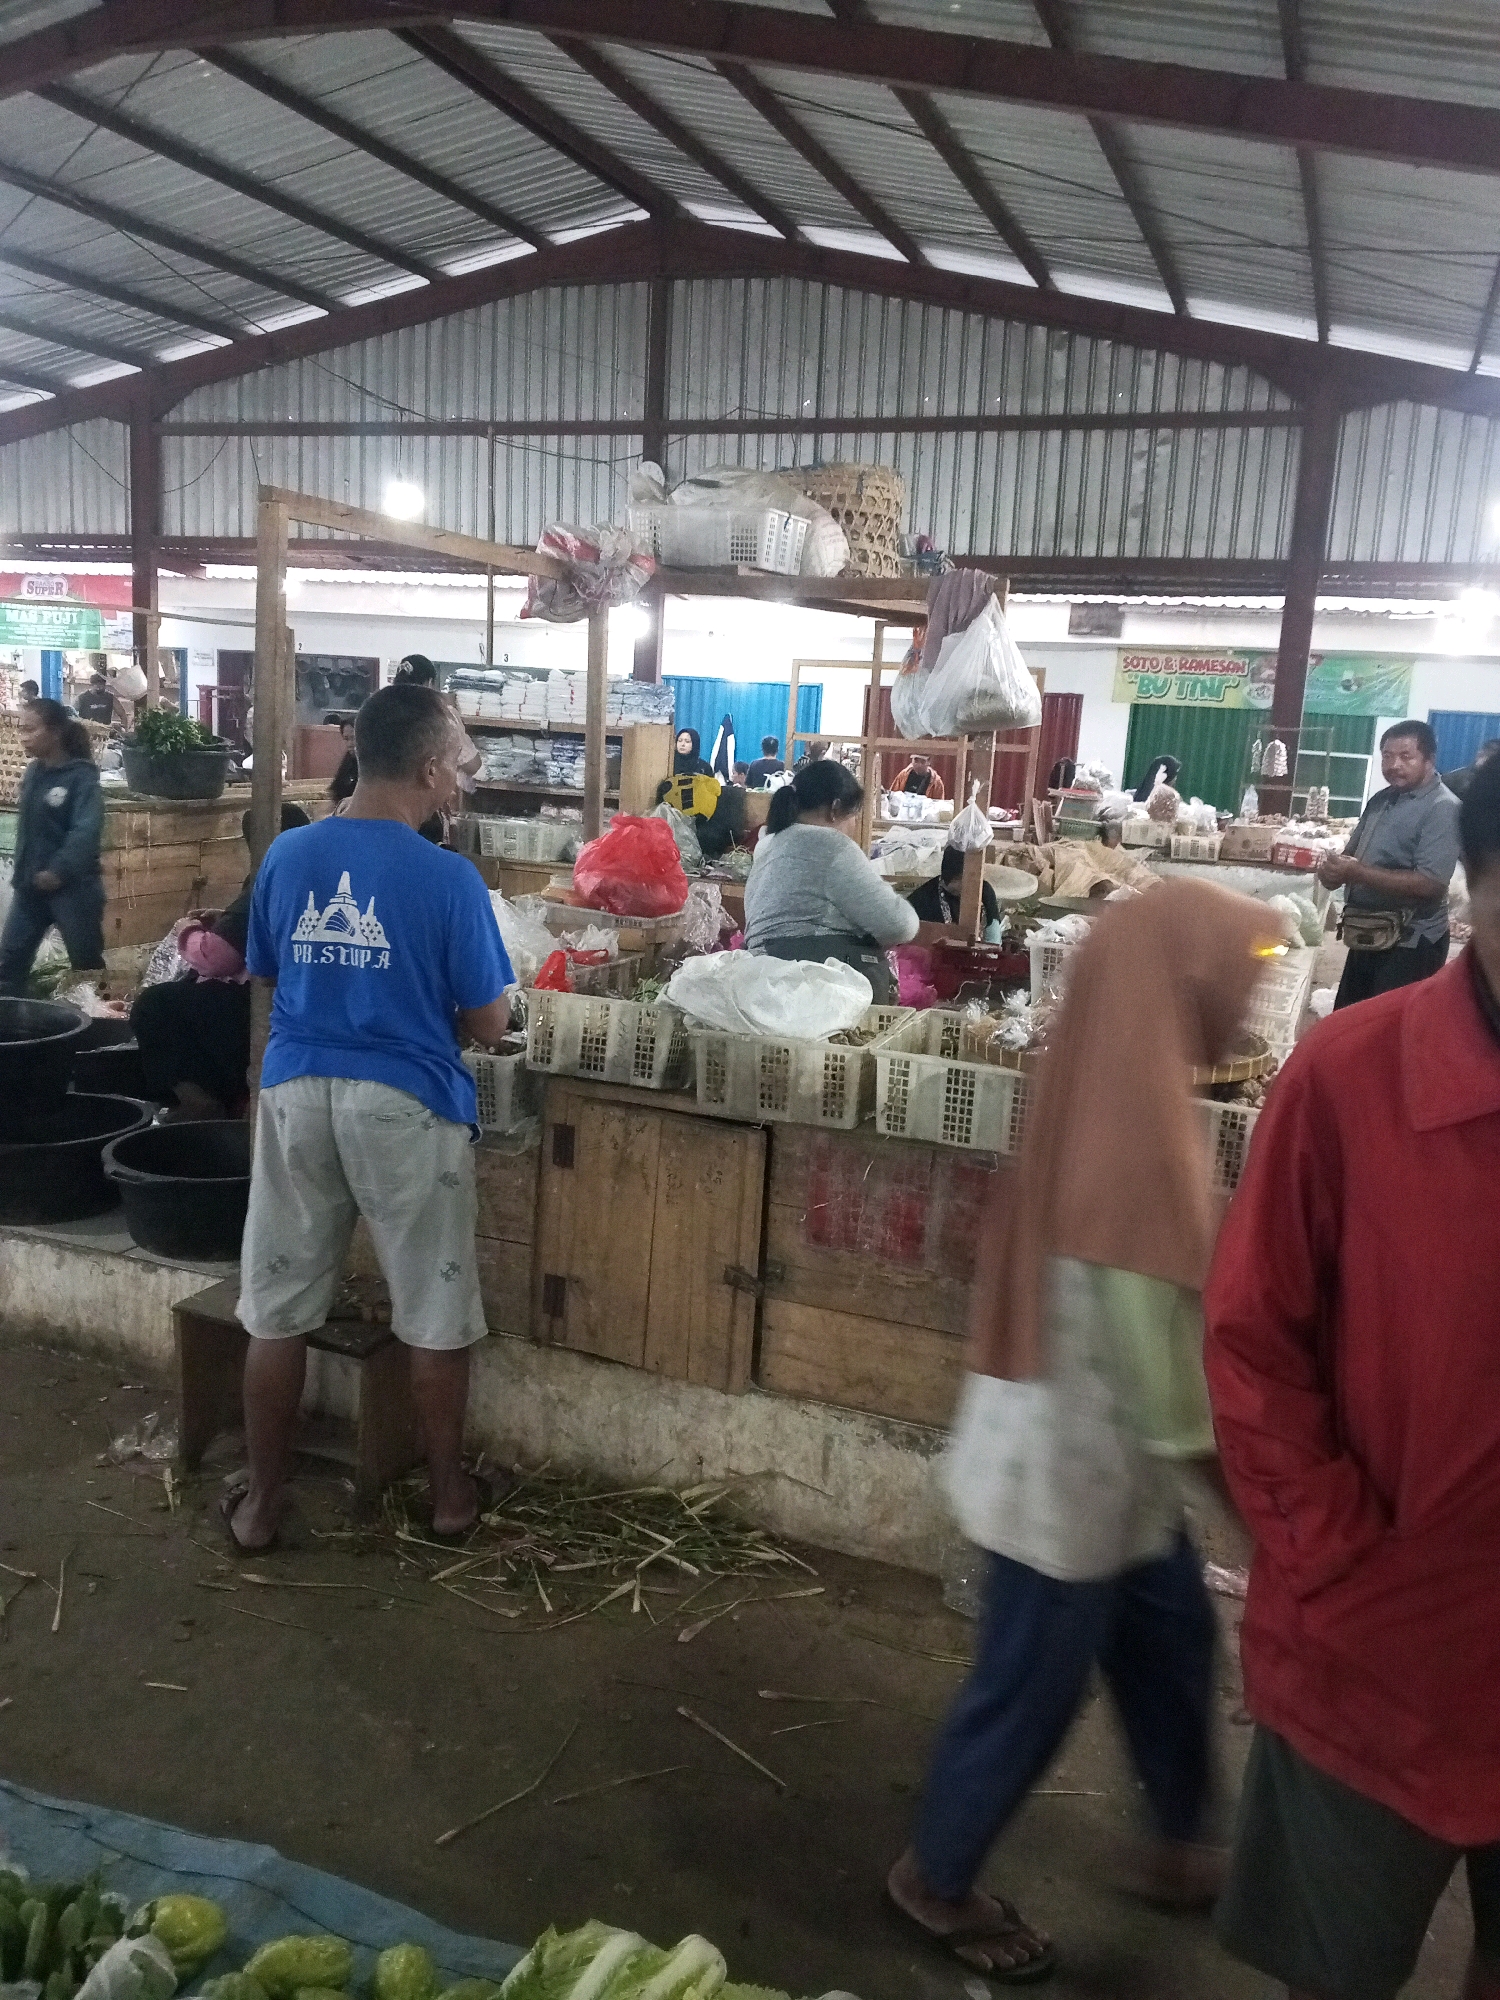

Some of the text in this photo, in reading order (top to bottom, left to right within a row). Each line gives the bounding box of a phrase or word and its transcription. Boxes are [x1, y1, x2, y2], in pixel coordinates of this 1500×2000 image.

[27, 580, 64, 596] SUPER
[41, 611, 78, 625] PUJI
[503, 653, 509, 663] 3
[1122, 655, 1249, 676] SOTO & RAMESAN
